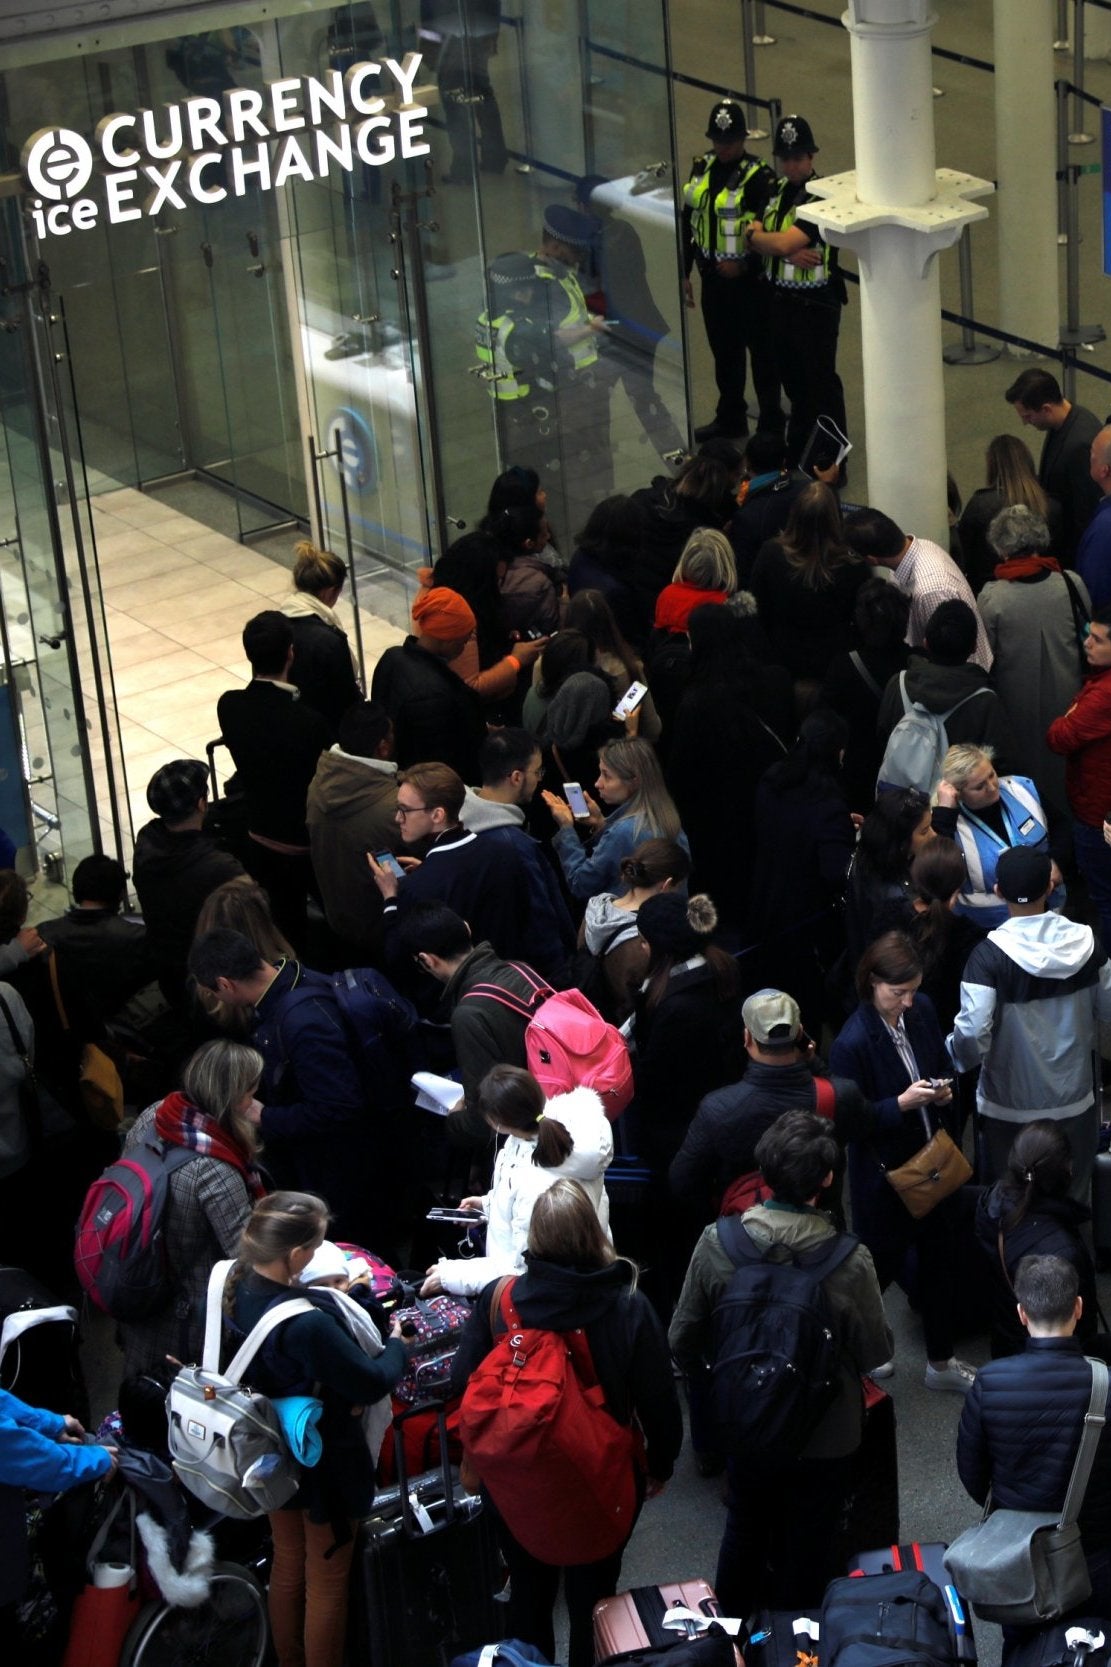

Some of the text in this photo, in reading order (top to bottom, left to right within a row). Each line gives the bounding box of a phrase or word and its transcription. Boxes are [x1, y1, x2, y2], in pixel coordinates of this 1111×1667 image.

[103, 54, 422, 168] CURRENCY
[105, 108, 430, 224] EXCHANGE
[32, 199, 98, 239] ice
